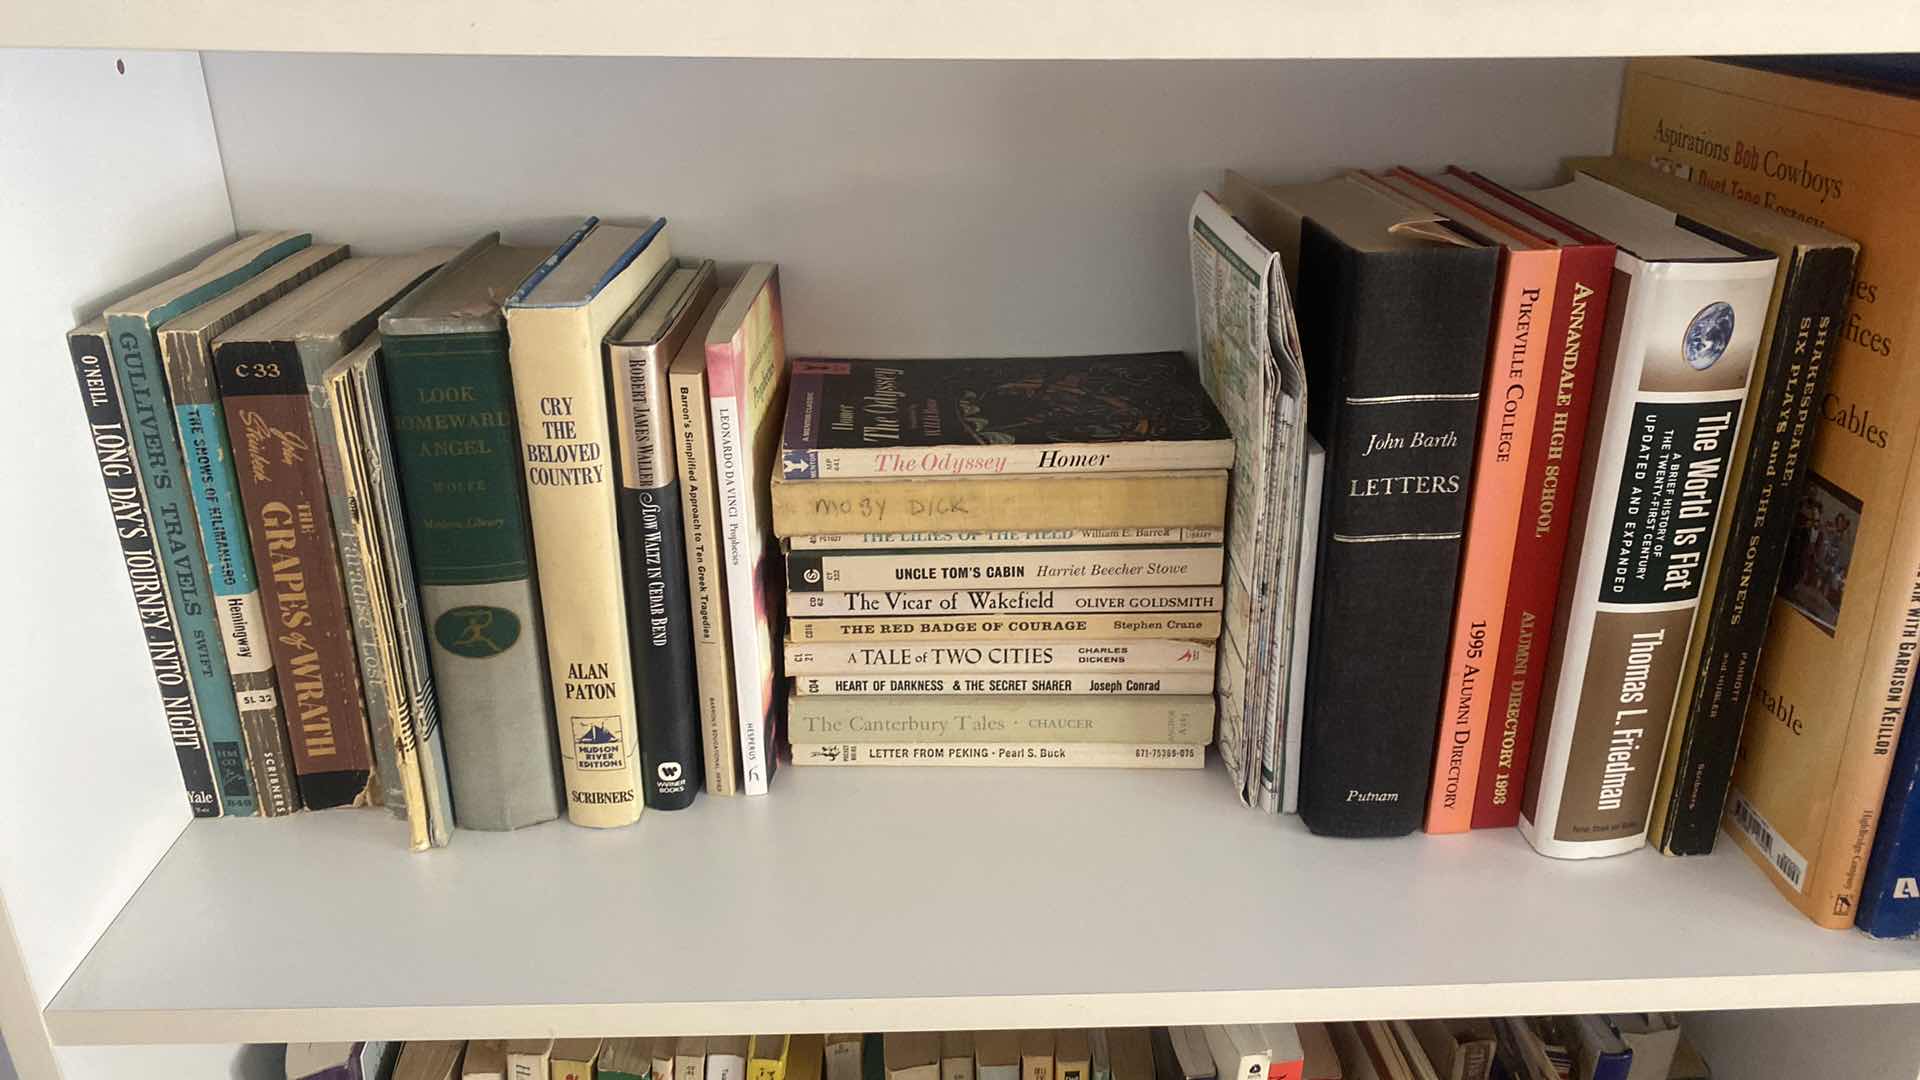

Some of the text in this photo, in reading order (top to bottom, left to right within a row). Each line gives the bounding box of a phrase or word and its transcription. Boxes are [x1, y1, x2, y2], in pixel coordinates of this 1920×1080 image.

[1653, 118, 1731, 163] Aspirations
[1733, 140, 1759, 172] Bob
[1762, 150, 1844, 203] Cowboys
[1556, 281, 1594, 407] ANNANDALE
[235, 363, 281, 378] C 33
[1496, 287, 1541, 463] PIKEVILLE COLLEGE
[416, 385, 475, 403] LOOK
[540, 397, 573, 416] CRY
[188, 408, 201, 434] THE
[542, 420, 577, 440] THE
[629, 359, 655, 488] ROBERT JAMES WALLER
[1693, 411, 1732, 452] The
[1822, 392, 1889, 449] Cables
[1362, 431, 1457, 456] John Barth
[1548, 411, 1569, 460] HIGH
[194, 439, 214, 483] SNOWS
[527, 442, 601, 463] BELOVED
[720, 408, 739, 518] LEONARDO DA VINCI
[874, 452, 1007, 474] The Odyssey
[1036, 450, 1110, 469] Homer
[118, 331, 202, 617] GULLIVER'S TRAVELS
[529, 464, 604, 486] COUNTRY
[1731, 316, 1812, 625] SIX PLAYS and THE SONNETS
[204, 487, 218, 504] OF
[1350, 475, 1460, 497] LETTERS
[1678, 457, 1722, 519] World
[679, 387, 711, 639] Barron's Simplified Approach to Ten Greek Tragedies
[815, 497, 968, 520] MOBY DICK
[1613, 414, 1657, 593] UPDATED AND EXPANDED
[1635, 429, 1675, 581] THE TWENTY-FIRST CENTURY
[1653, 452, 1682, 558] A BRIEF HISTORY OF
[297, 502, 316, 534] THE
[81, 355, 201, 750] O'NEILL LONG DAY'S JOURNEY INTO NIGHT
[643, 531, 662, 565] WALTZ
[261, 501, 313, 630] GRAPES
[647, 567, 662, 579] IN
[895, 565, 1025, 580] UNCLE TOM'S CABIN
[1037, 562, 1188, 577] Harriet Beecher Stowe
[1663, 551, 1701, 592] Flat
[648, 581, 665, 615] CEDAR
[844, 590, 1054, 611] The Vicar of Wakefield
[1075, 596, 1214, 608] OLIVER GOLDSMITH
[227, 598, 253, 659] Hemingway
[651, 616, 669, 647] BEND
[840, 620, 1087, 635] THE RED BADGE OF COURAGE
[1114, 620, 1203, 631] Stephen Crane
[193, 629, 213, 678] SWIFT
[847, 647, 1054, 666] A TALE of TWO CITIES
[568, 663, 609, 680] ALAN
[1620, 628, 1665, 704] Thomas
[565, 682, 617, 700] PATON
[835, 679, 1072, 692] HEART OF DARKNESS & THE SECRET SHARER
[1089, 679, 1161, 693] Joseph Conrad
[1499, 611, 1537, 769] ALUMNI DIRECTORY
[1872, 606, 1920, 756] WITH GARRISON KEILLOR
[244, 695, 256, 704] SL
[290, 651, 337, 758] WRATH
[803, 715, 1005, 736] The Canterbury Tales
[1028, 719, 1094, 729] CHAUCER
[1443, 620, 1487, 809] 1995 ALUMNI DIRECTORY
[1615, 708, 1648, 726] L.
[579, 745, 619, 754] HUDSON
[585, 752, 614, 761] RIVER
[869, 748, 989, 759] LETTER FROM PEKING
[999, 748, 1066, 758] Pearl S. Buck
[578, 759, 623, 769] EDITIONS
[1597, 728, 1644, 811] Friedman
[264, 752, 286, 814] SCRIBNERS
[186, 790, 213, 803] Yale
[572, 790, 635, 805] SCRIBNERS
[1347, 790, 1399, 802] Putnam
